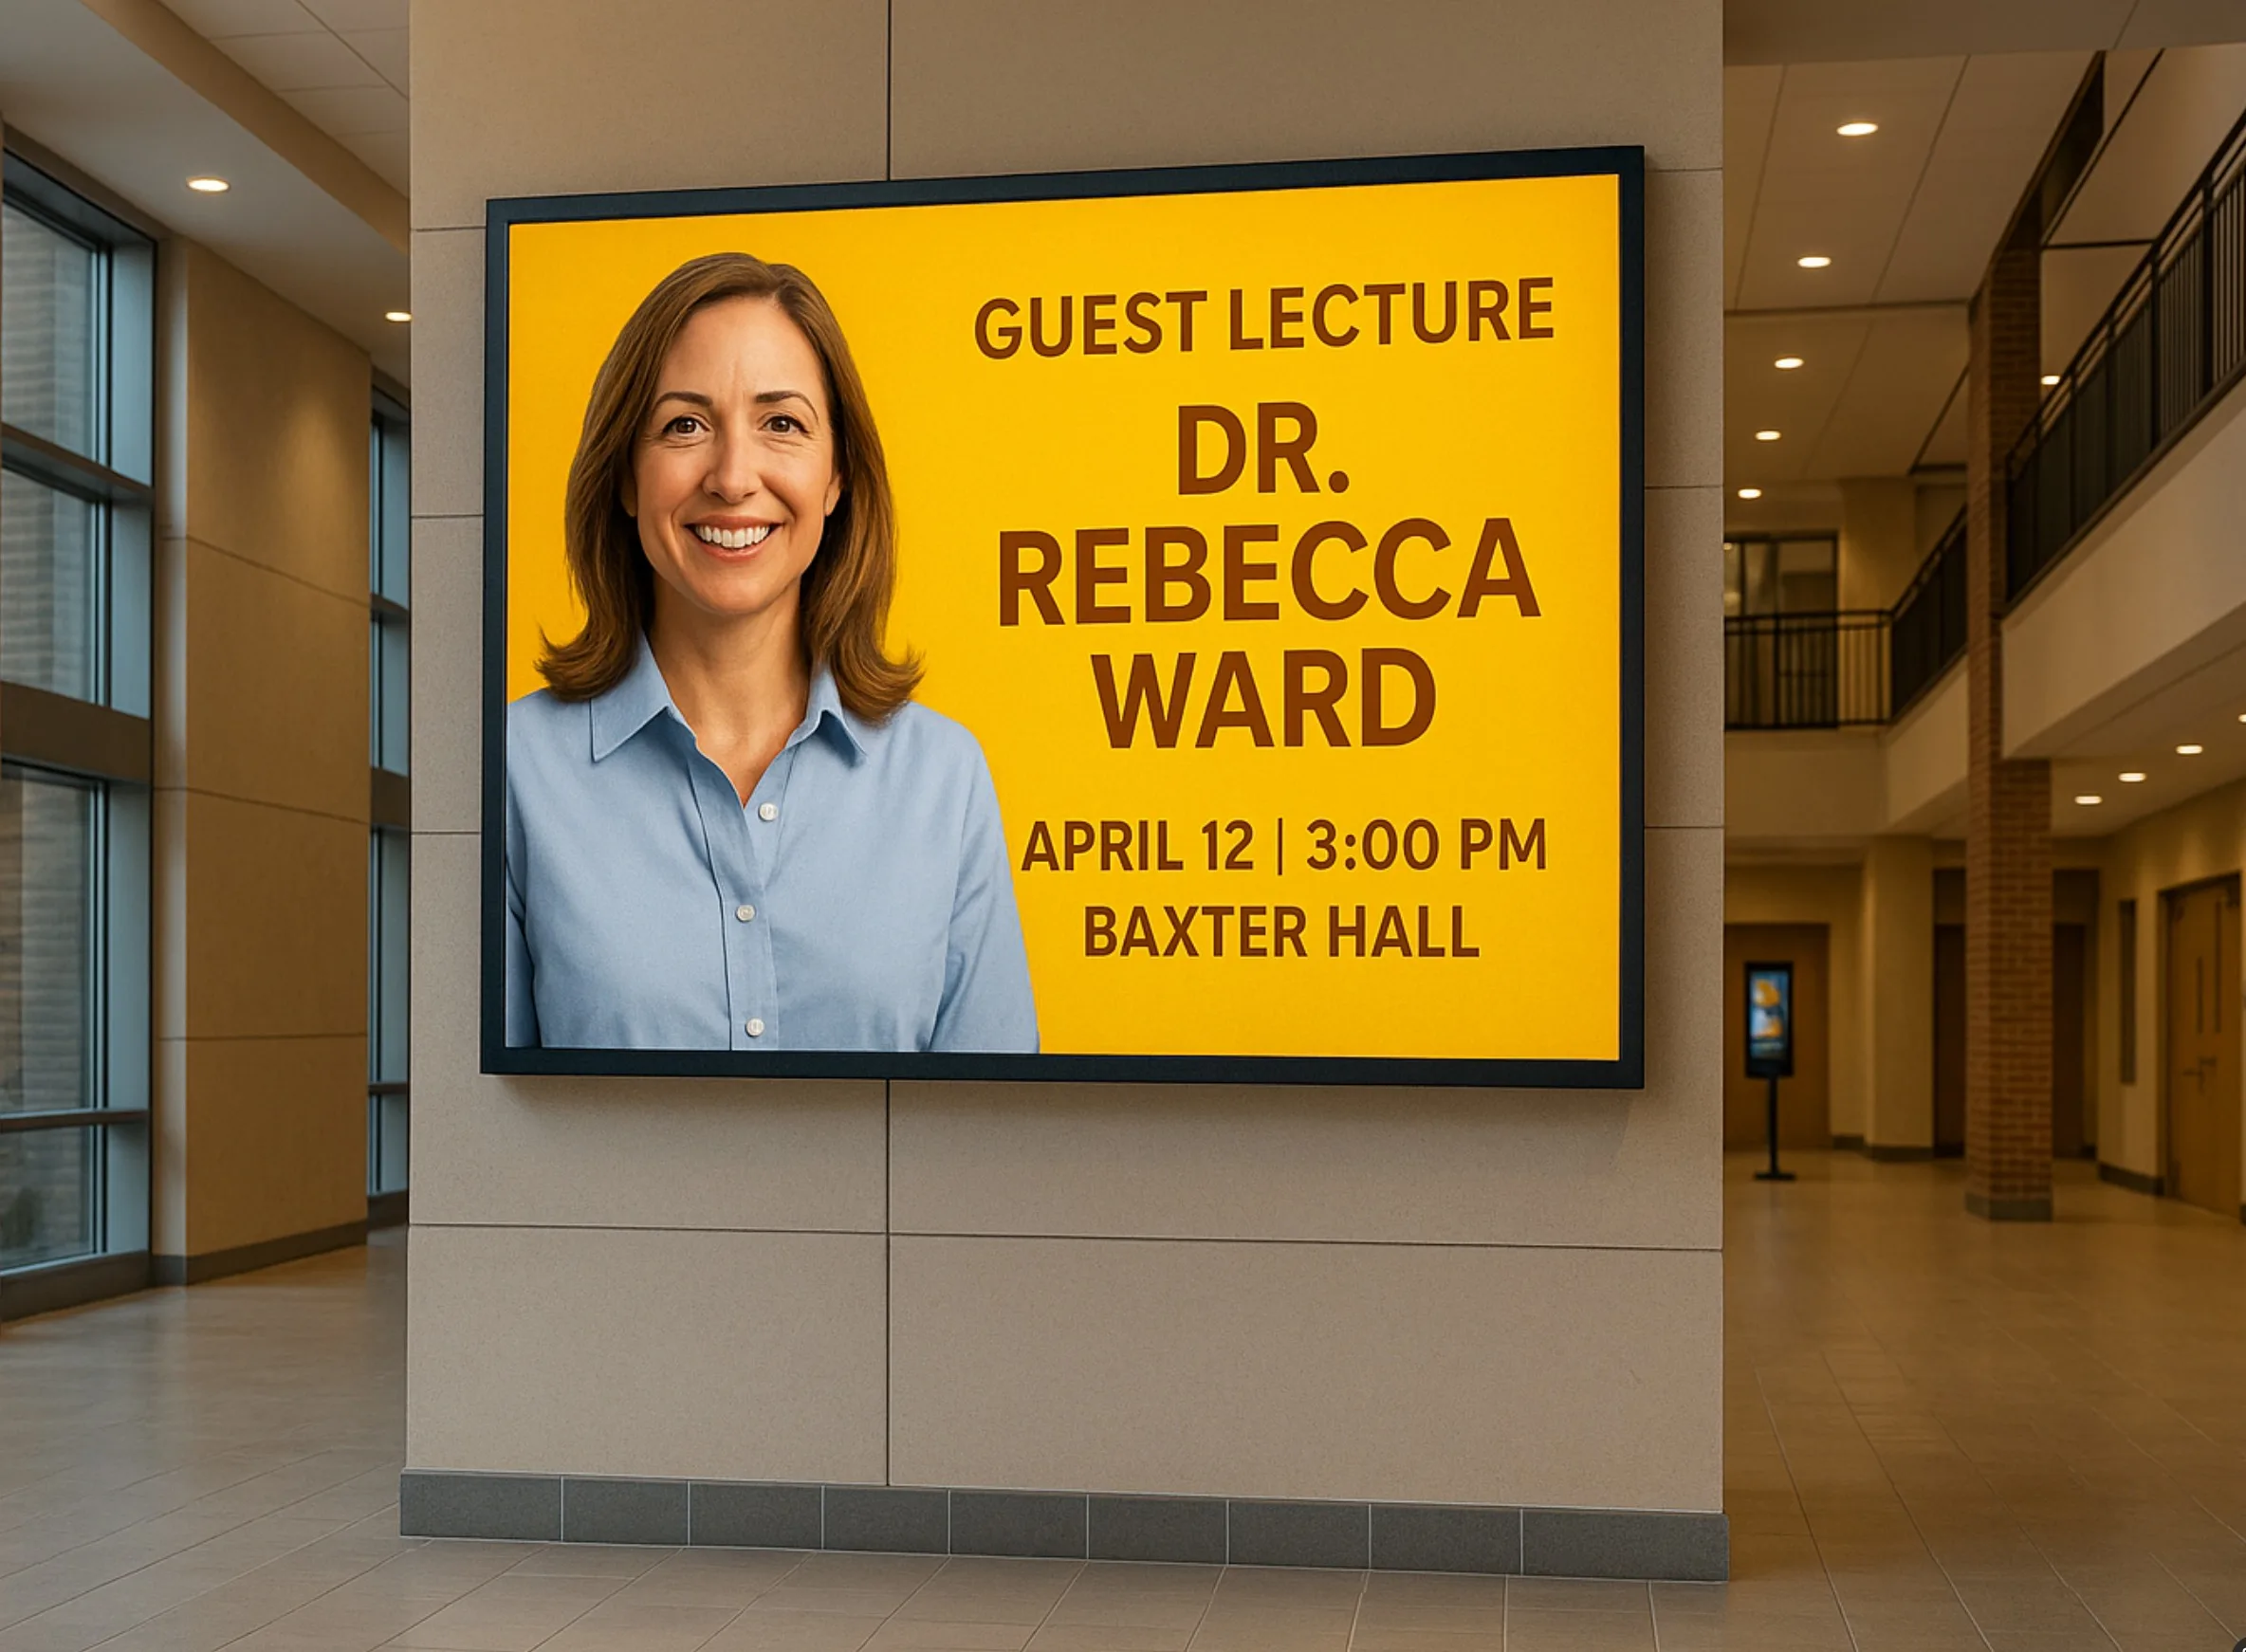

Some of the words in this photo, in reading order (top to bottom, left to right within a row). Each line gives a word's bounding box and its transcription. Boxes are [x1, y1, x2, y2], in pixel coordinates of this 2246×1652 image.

[974, 289, 1208, 360] GUEST
[1229, 276, 1555, 351] LECTURE
[1178, 401, 1350, 496] DR.
[999, 517, 1542, 627] REBECCA
[1090, 647, 1437, 749] WARD
[1021, 819, 1185, 872] APRIL
[1201, 819, 1254, 871] 12
[1306, 818, 1440, 871] 3:00
[1460, 817, 1547, 871] PM
[1084, 905, 1308, 958] BAXTER
[1328, 905, 1481, 958] HALL
